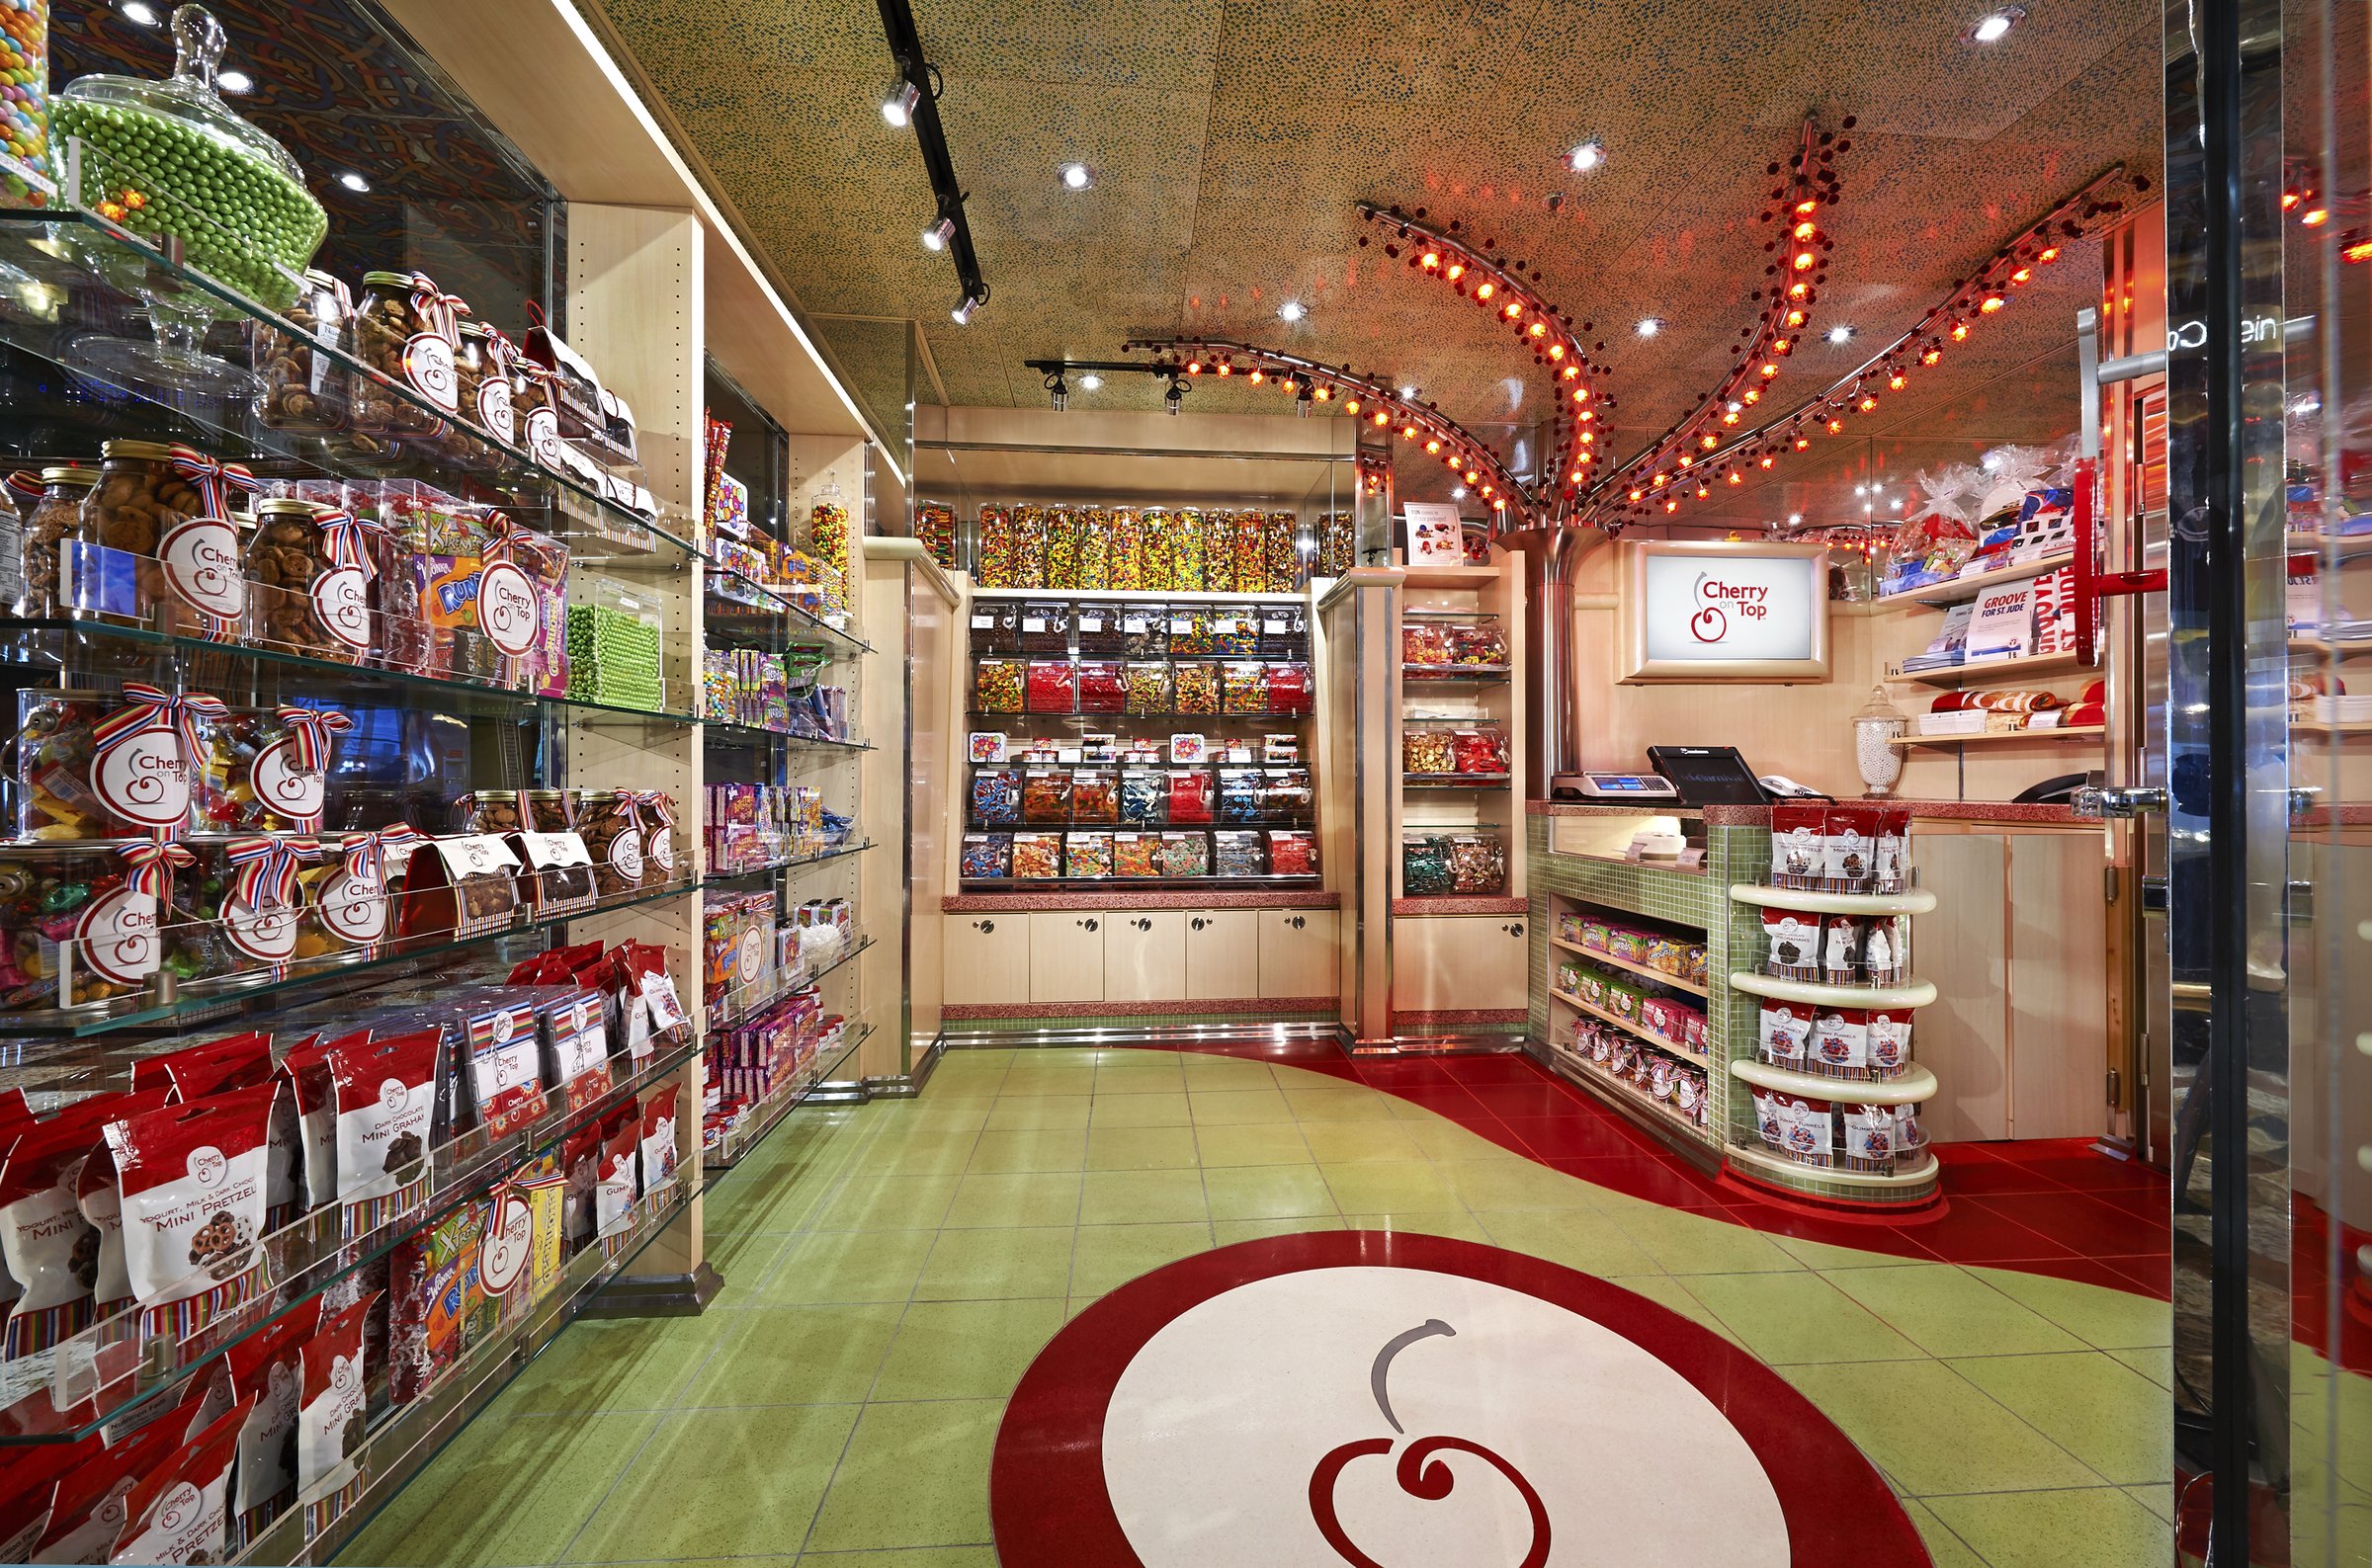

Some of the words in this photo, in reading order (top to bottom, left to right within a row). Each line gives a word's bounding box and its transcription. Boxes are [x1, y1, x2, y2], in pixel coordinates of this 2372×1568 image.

[499, 587, 531, 609] Cherry
[1703, 581, 1769, 603] Cherry
[1984, 591, 2029, 610] GROOVE
[515, 606, 531, 621] Top
[1720, 600, 1735, 610] on
[1737, 601, 1767, 620] Top
[1982, 608, 1996, 619] FOR
[2006, 603, 2025, 615] JUDE
[156, 770, 170, 779] on
[172, 771, 188, 785] Top
[311, 773, 324, 785] Top
[498, 1054, 518, 1067] Cherry
[386, 1086, 403, 1096] Cherry
[507, 1096, 524, 1107] Cherry
[375, 1120, 392, 1130] DARK
[392, 1105, 424, 1122] CHOCOLATE
[362, 1128, 390, 1144] MINI
[198, 1154, 220, 1167] Cherry
[139, 1207, 183, 1224] YOGURT,
[186, 1197, 207, 1208] MILK
[214, 1188, 231, 1197] DARK
[32, 1219, 74, 1241] MINI
[156, 1211, 195, 1233] MINI
[505, 1215, 528, 1235] herry
[513, 1230, 527, 1244] Top
[110, 1409, 147, 1431] Nutrition
[324, 1414, 343, 1436] MINI
[165, 1487, 192, 1511] Cherry
[180, 1494, 196, 1507] Top
[155, 1544, 176, 1562] MILK
[187, 1520, 208, 1538] DARK
